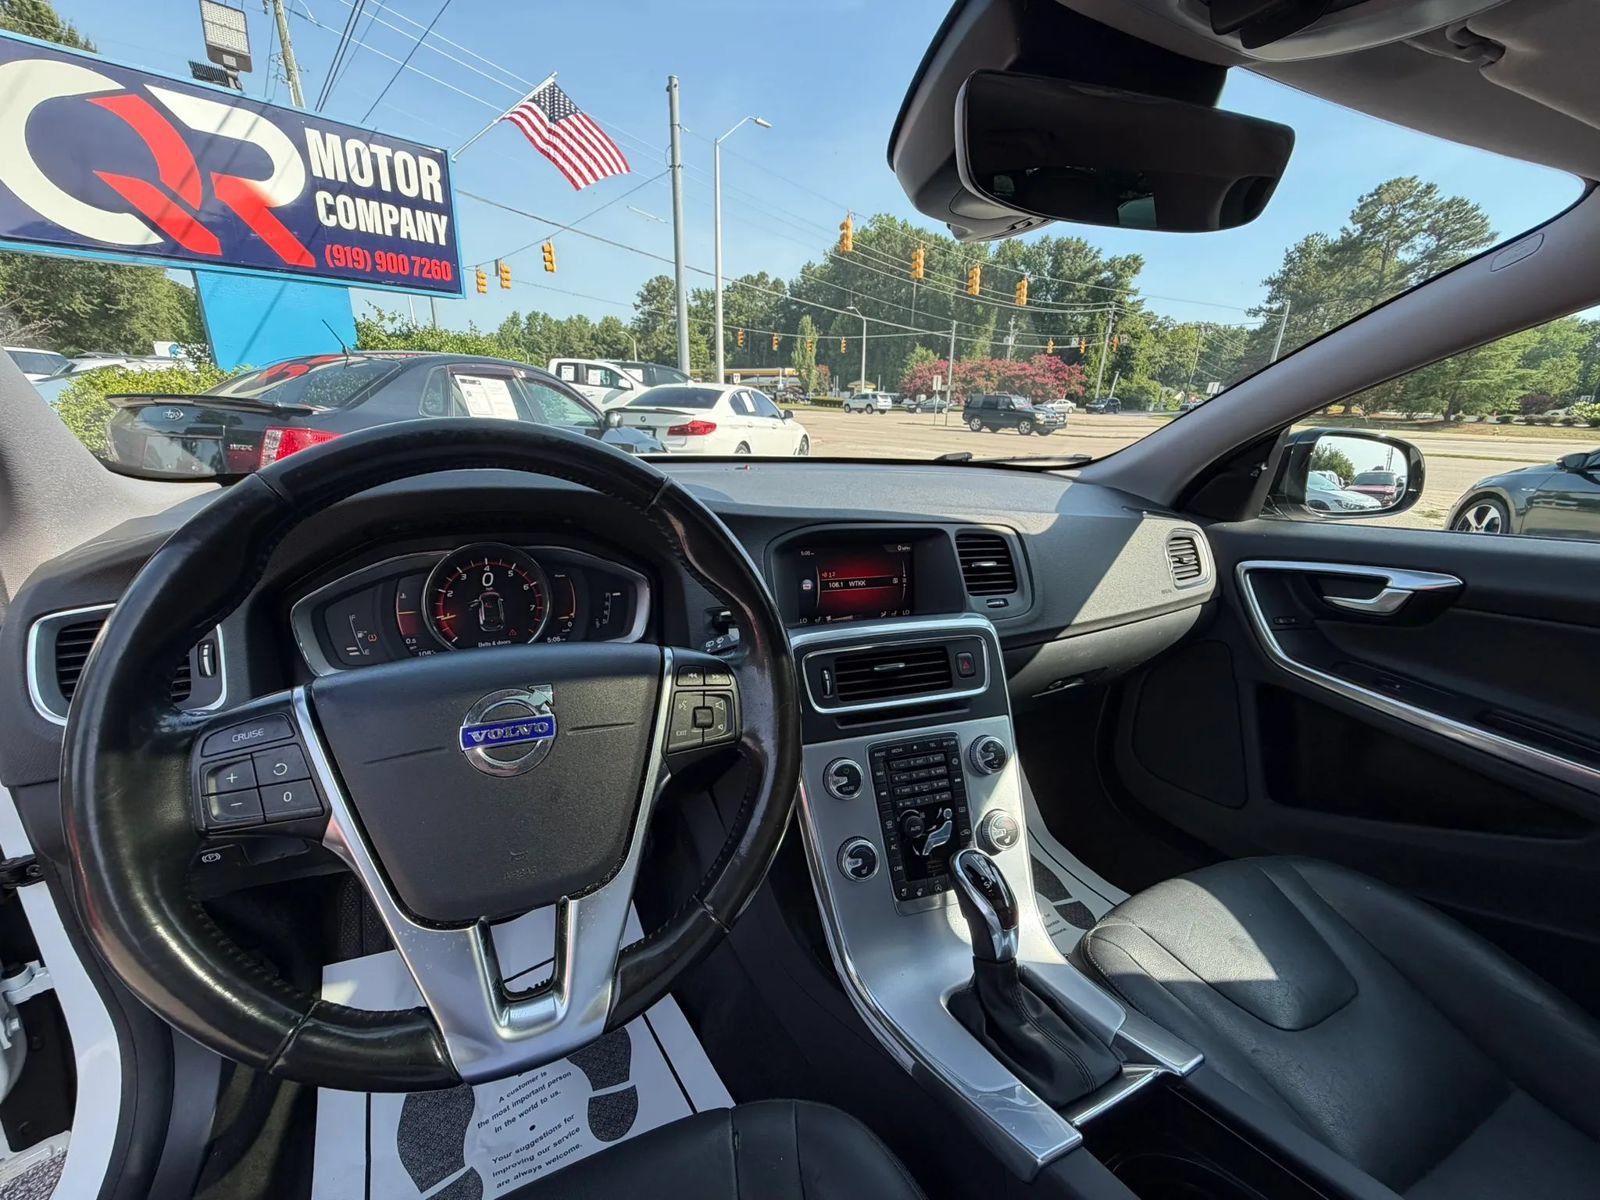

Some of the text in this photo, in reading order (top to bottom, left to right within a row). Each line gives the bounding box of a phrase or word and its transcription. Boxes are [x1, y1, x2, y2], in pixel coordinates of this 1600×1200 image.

[304, 127, 443, 204] MOTOR
[315, 190, 448, 246] COMPANY
[325, 244, 453, 281] (919) 900 7260
[482, 572, 494, 587] 0
[523, 583, 529, 591] 6
[231, 728, 265, 743] CRUISE
[467, 721, 549, 743] VOLVO
[477, 1071, 572, 1129] the most important person
[506, 1074, 539, 1098] customer
[494, 1091, 561, 1134] in the world to us.
[492, 1114, 575, 1164] Your suggestions for
[492, 1127, 581, 1178] improving our service
[496, 1143, 583, 1189] are always welcome.
